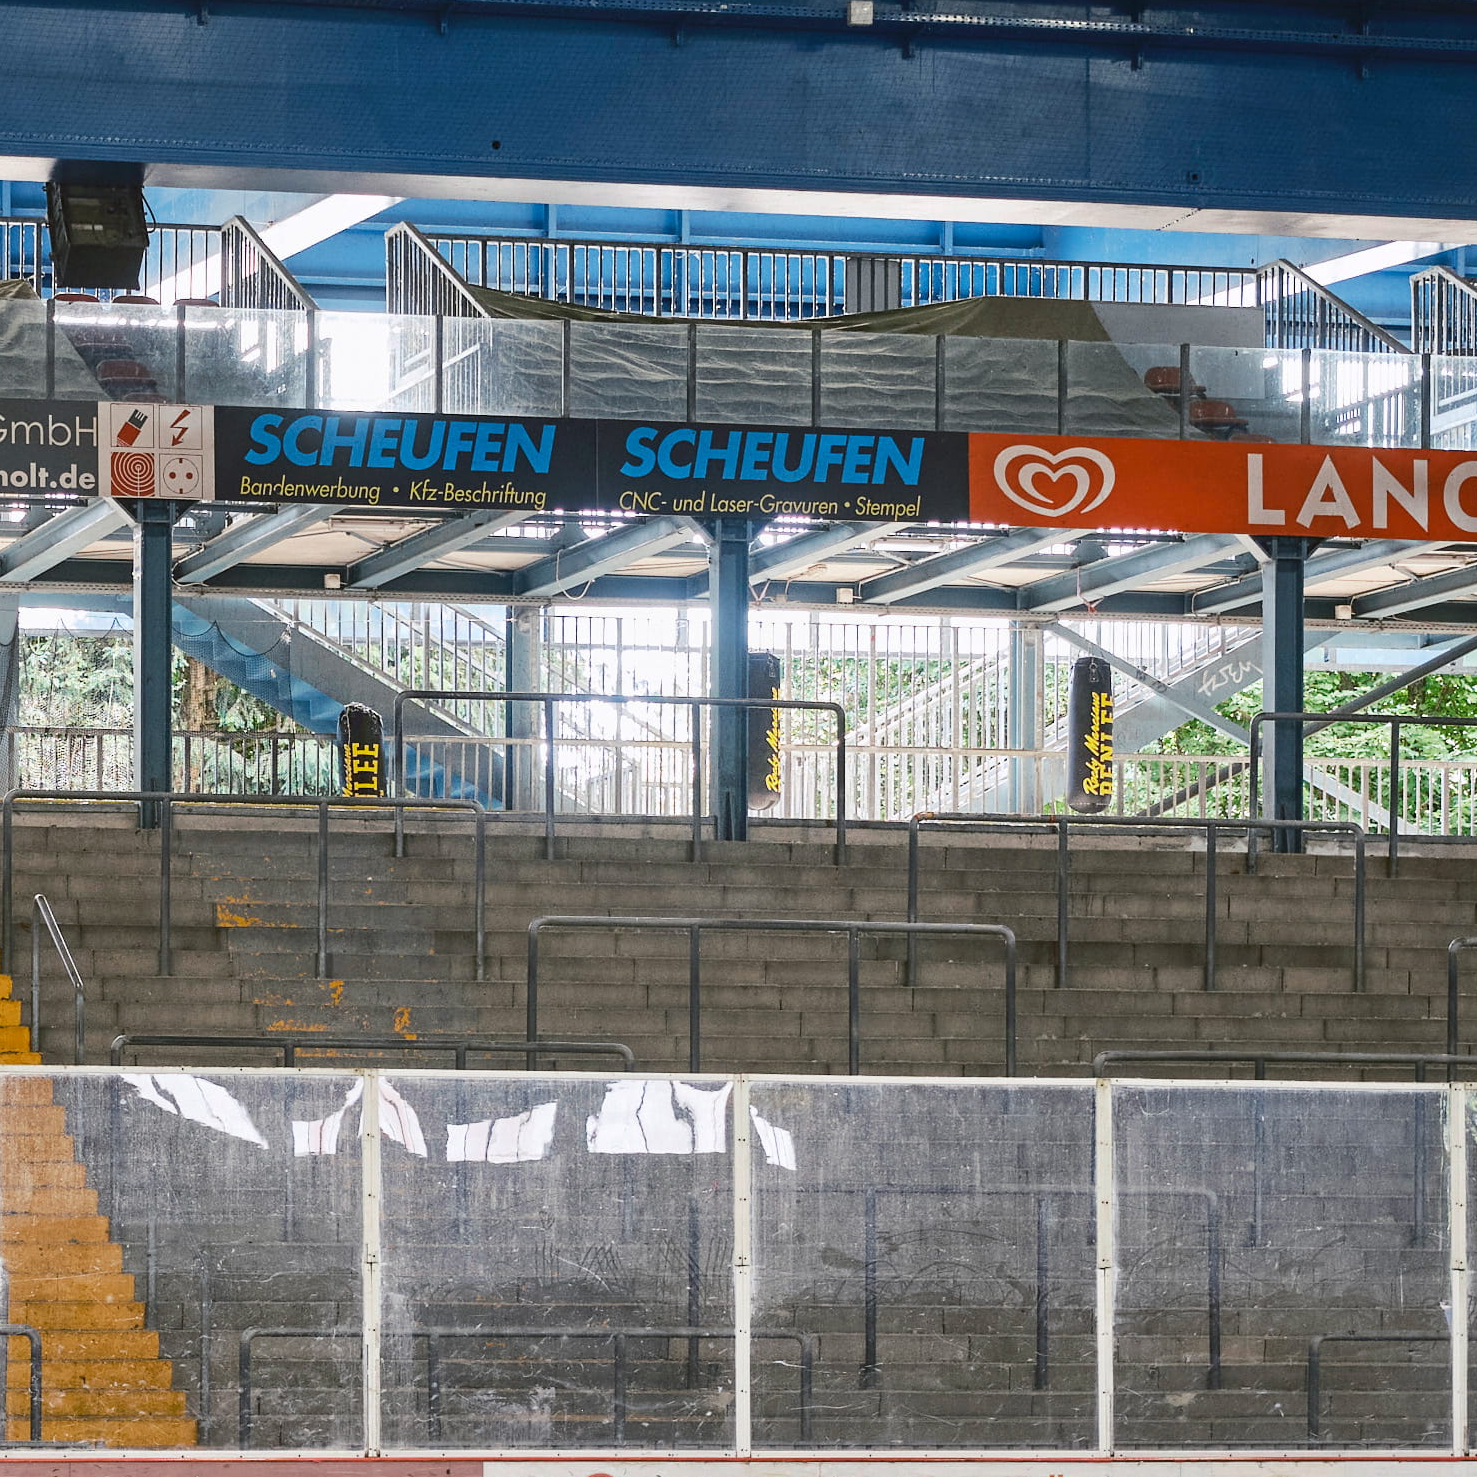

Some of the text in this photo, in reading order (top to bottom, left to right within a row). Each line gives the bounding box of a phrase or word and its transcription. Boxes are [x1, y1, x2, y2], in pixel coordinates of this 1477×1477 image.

[244, 413, 556, 474] SCHEUFEN
[619, 426, 925, 486] SCHEUFEN
[240, 475, 546, 511] Bandenwerbung Kfz-Beschriftung
[619, 491, 921, 522] CNC- und Laser-Gravuren Stempel
